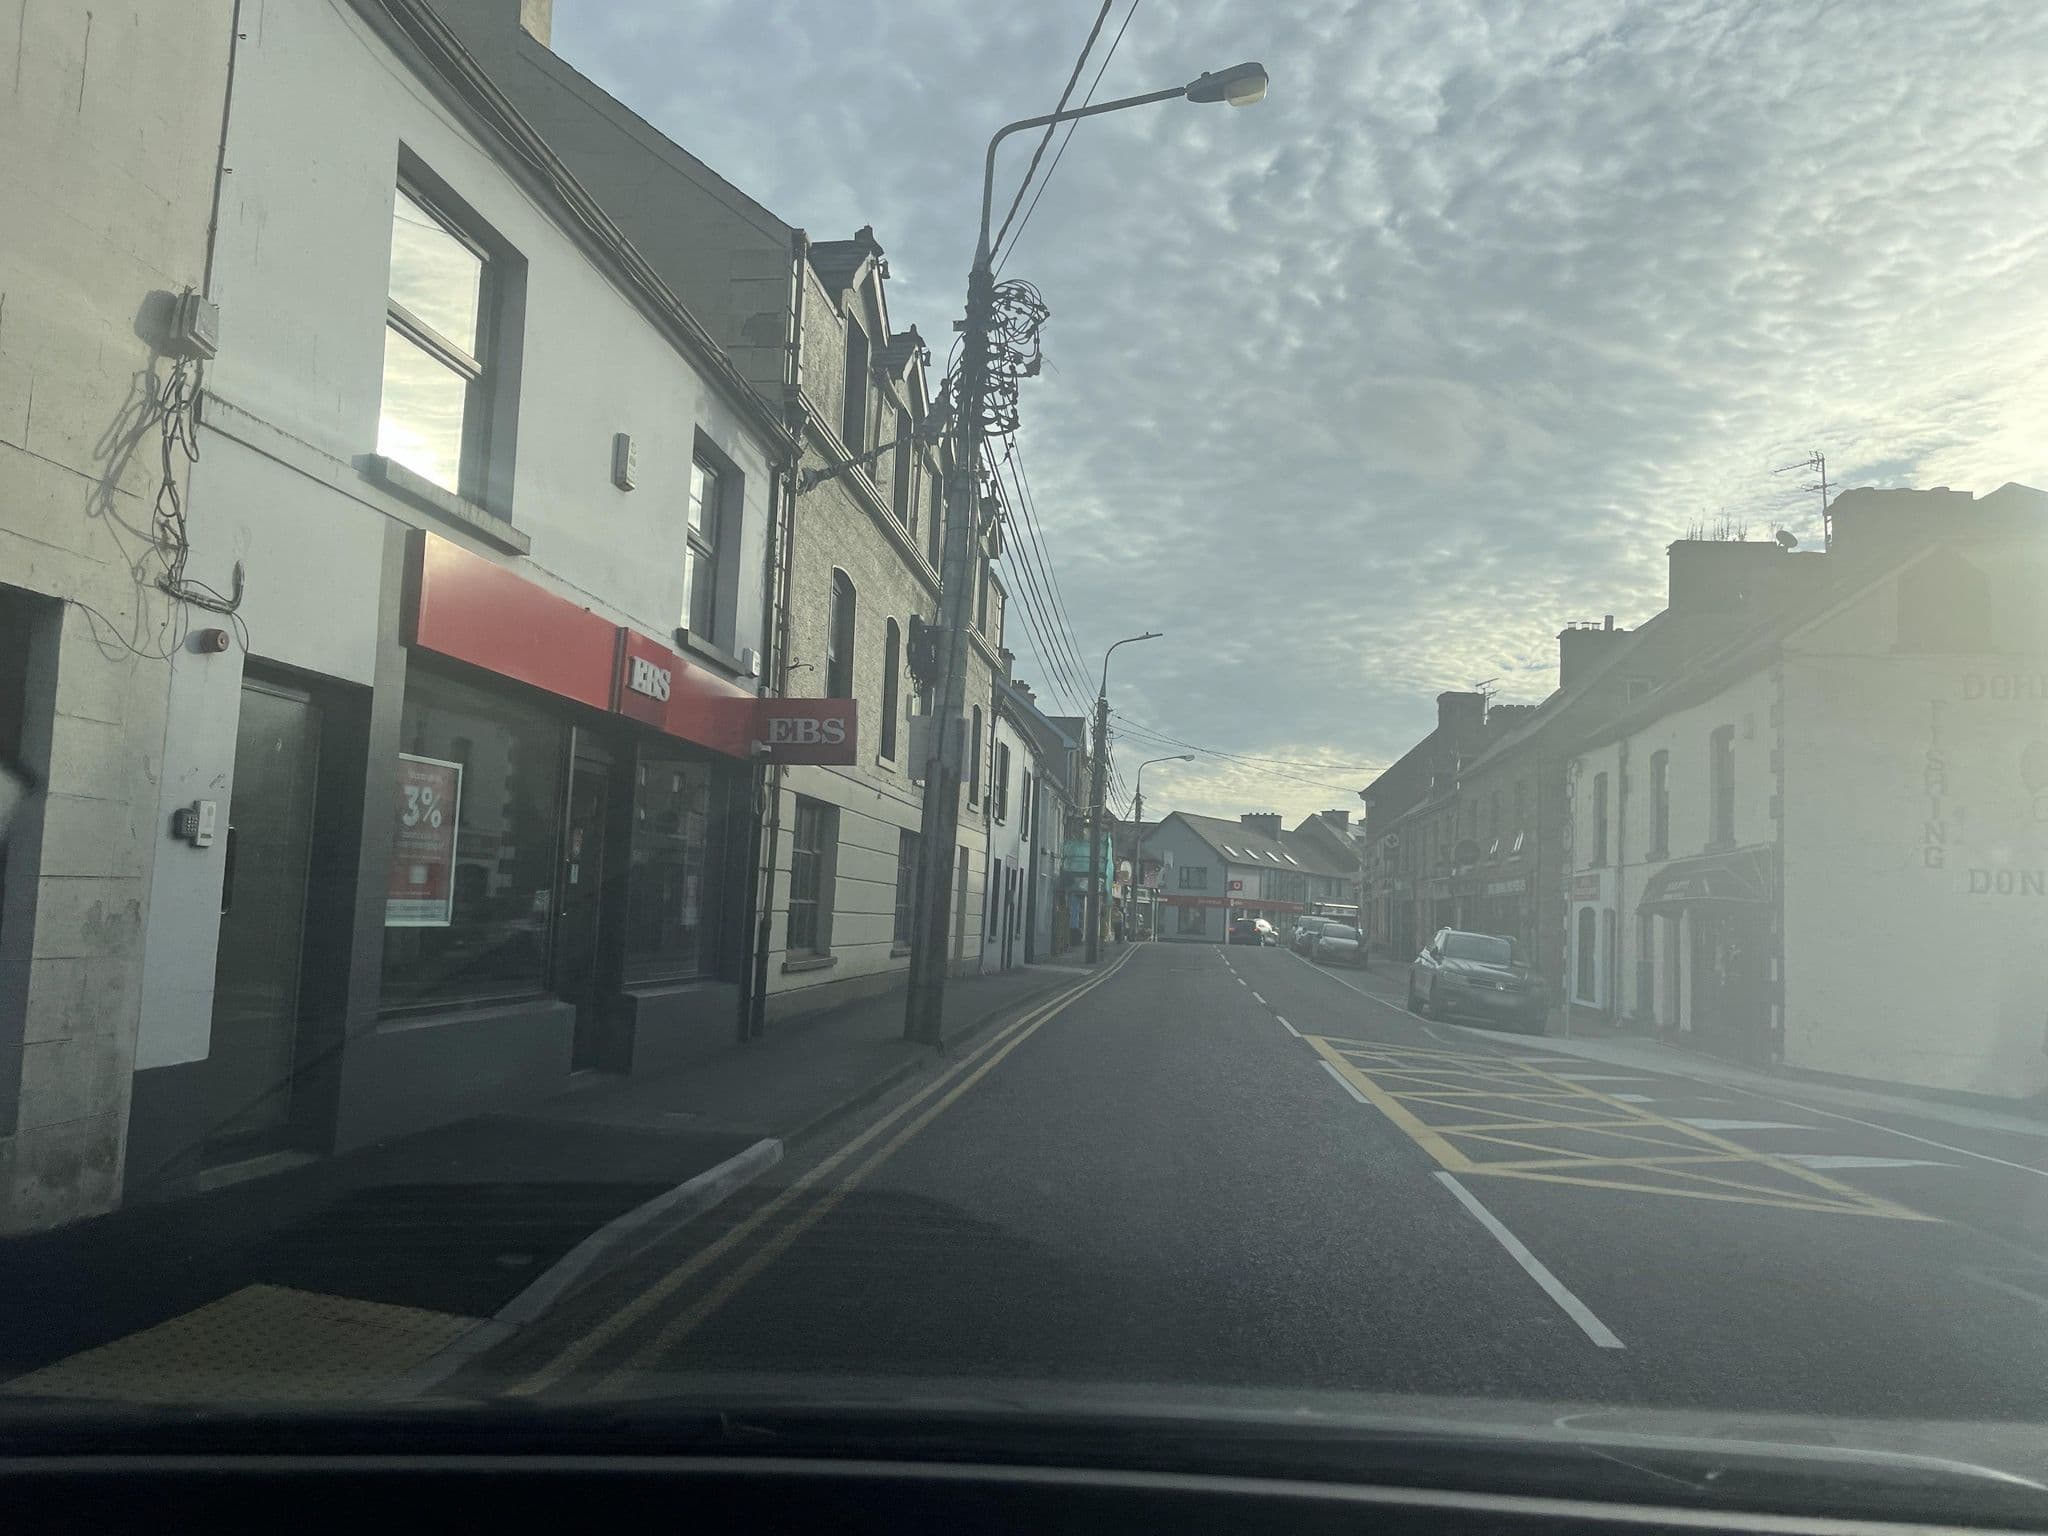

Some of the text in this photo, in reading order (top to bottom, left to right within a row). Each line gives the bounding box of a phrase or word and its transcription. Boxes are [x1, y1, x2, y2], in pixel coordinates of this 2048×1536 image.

[628, 655, 672, 703] EBS
[766, 717, 846, 745] EBS
[402, 784, 442, 829] 3%
